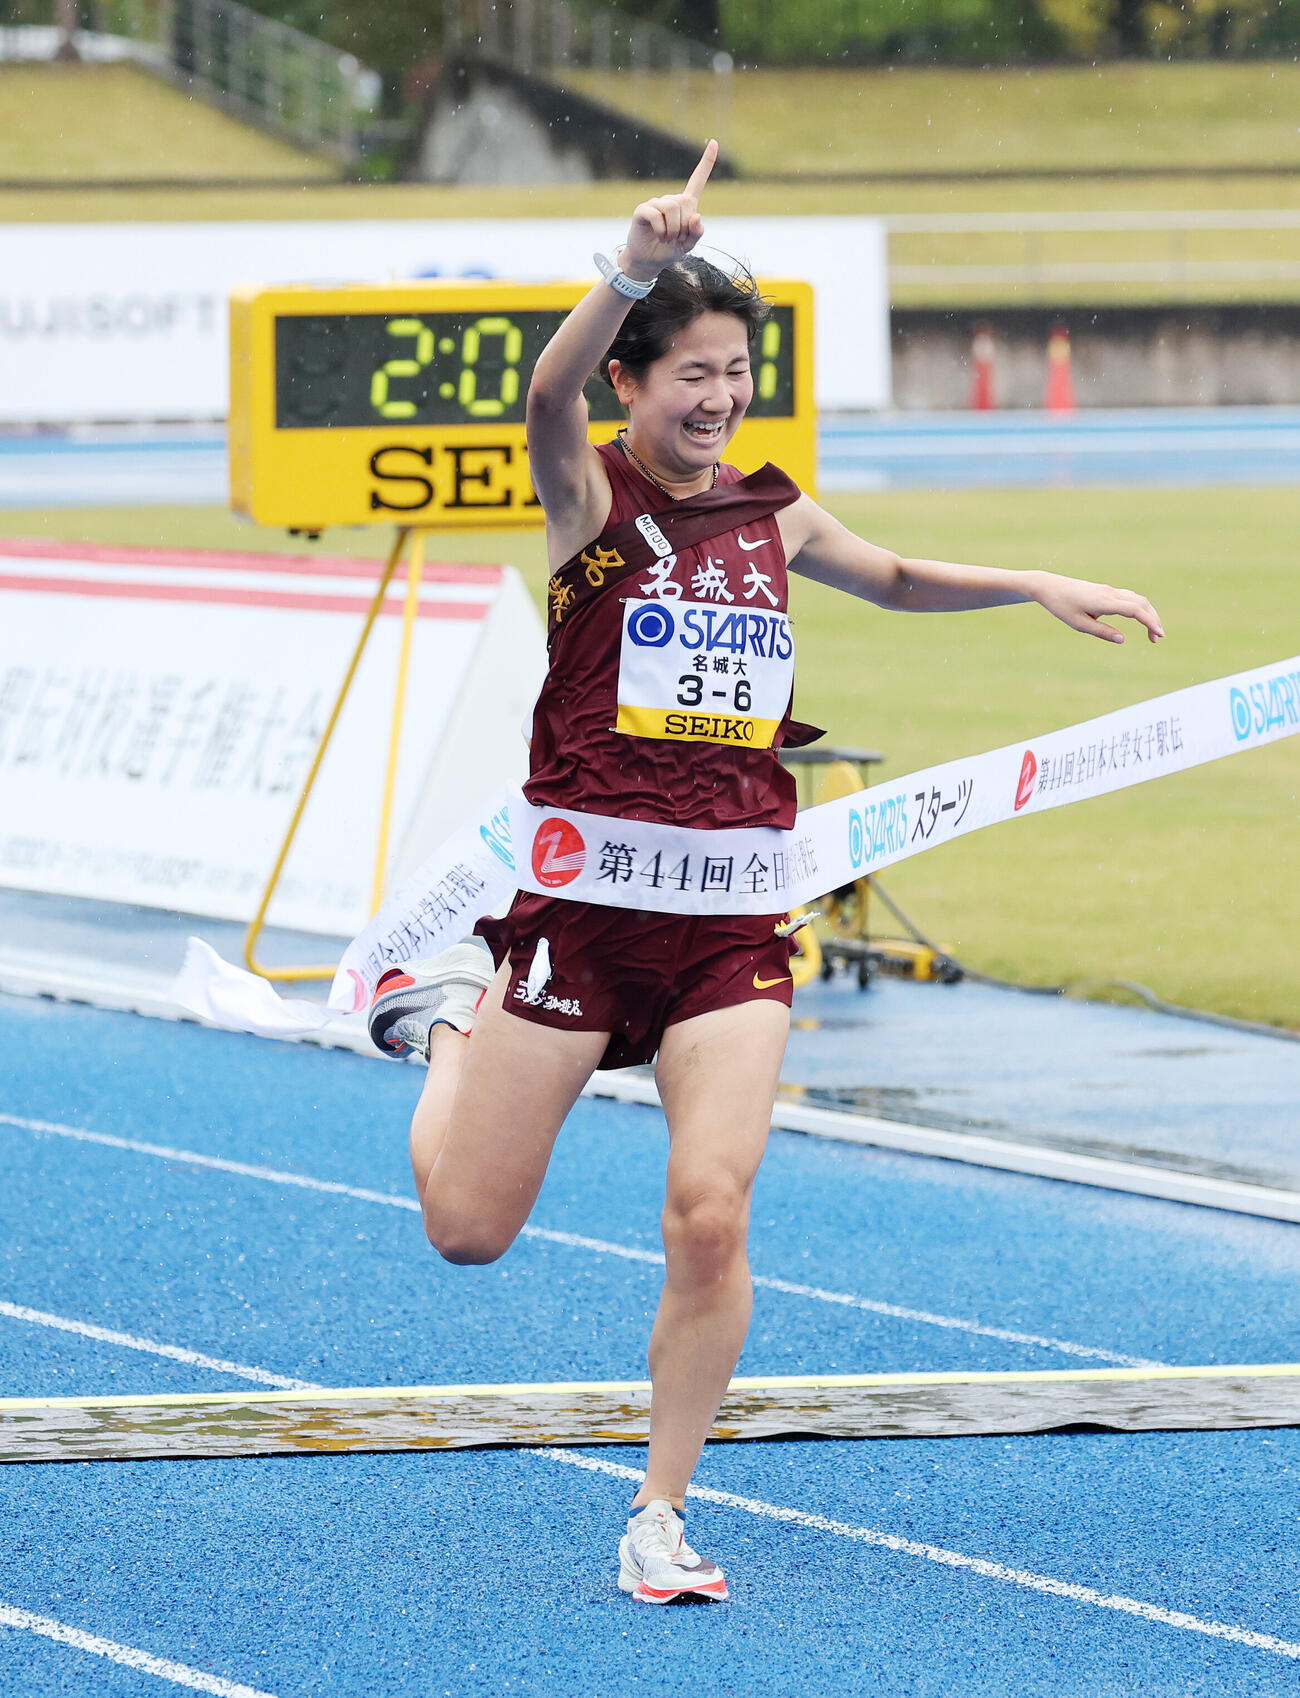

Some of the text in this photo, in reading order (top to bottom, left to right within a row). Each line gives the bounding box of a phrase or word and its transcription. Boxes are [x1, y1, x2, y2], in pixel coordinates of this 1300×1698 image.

[638, 554, 780, 607] 名城大
[679, 608, 793, 660] STARTS
[692, 654, 748, 676] 名城大
[664, 714, 755, 741] SEIKO
[1249, 671, 1300, 735] START
[864, 779, 973, 862] STARTS スターツ
